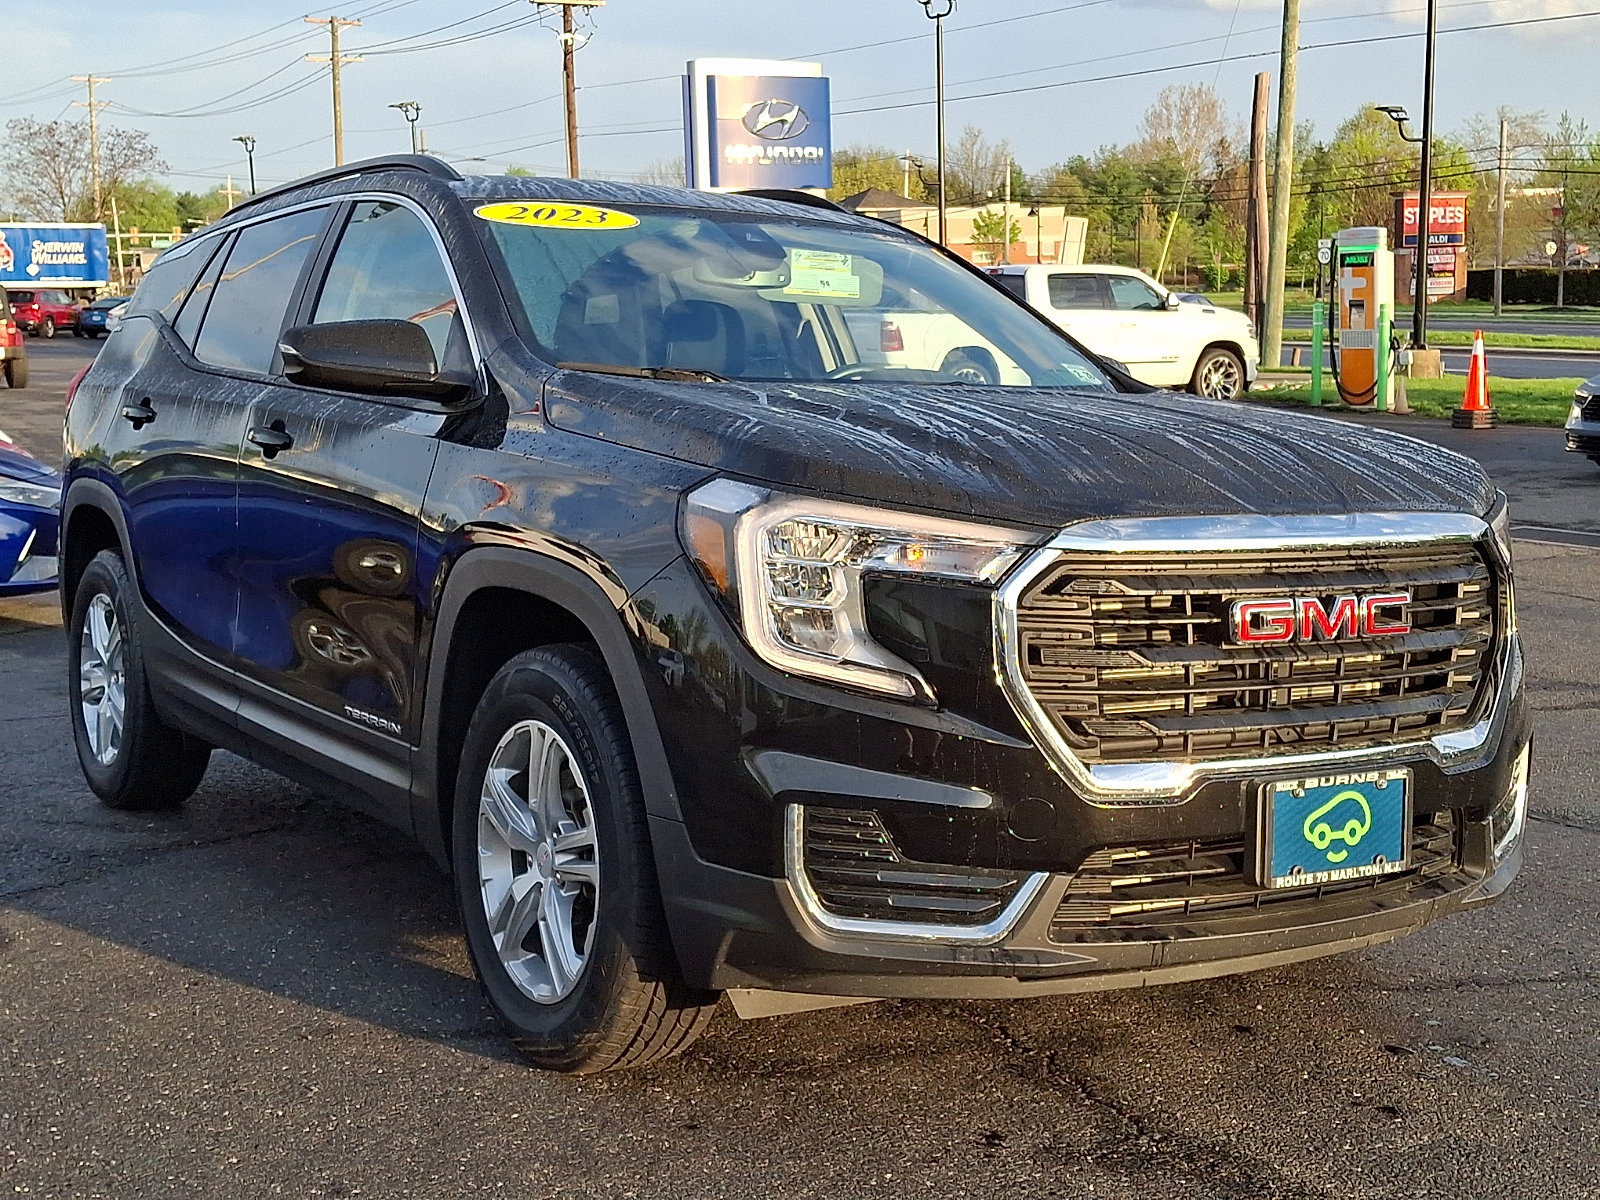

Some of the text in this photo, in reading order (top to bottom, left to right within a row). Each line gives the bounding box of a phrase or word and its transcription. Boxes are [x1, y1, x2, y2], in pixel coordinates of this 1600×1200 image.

[505, 206, 608, 224] 2023
[1405, 206, 1464, 224] STPLES
[33, 240, 84, 253] SHERWIN
[1429, 235, 1448, 243] ALDI
[1320, 251, 1330, 260] 70
[1230, 593, 1411, 644] GMC
[344, 705, 402, 735] TERRAIN
[1276, 873, 1314, 888] ROUTE
